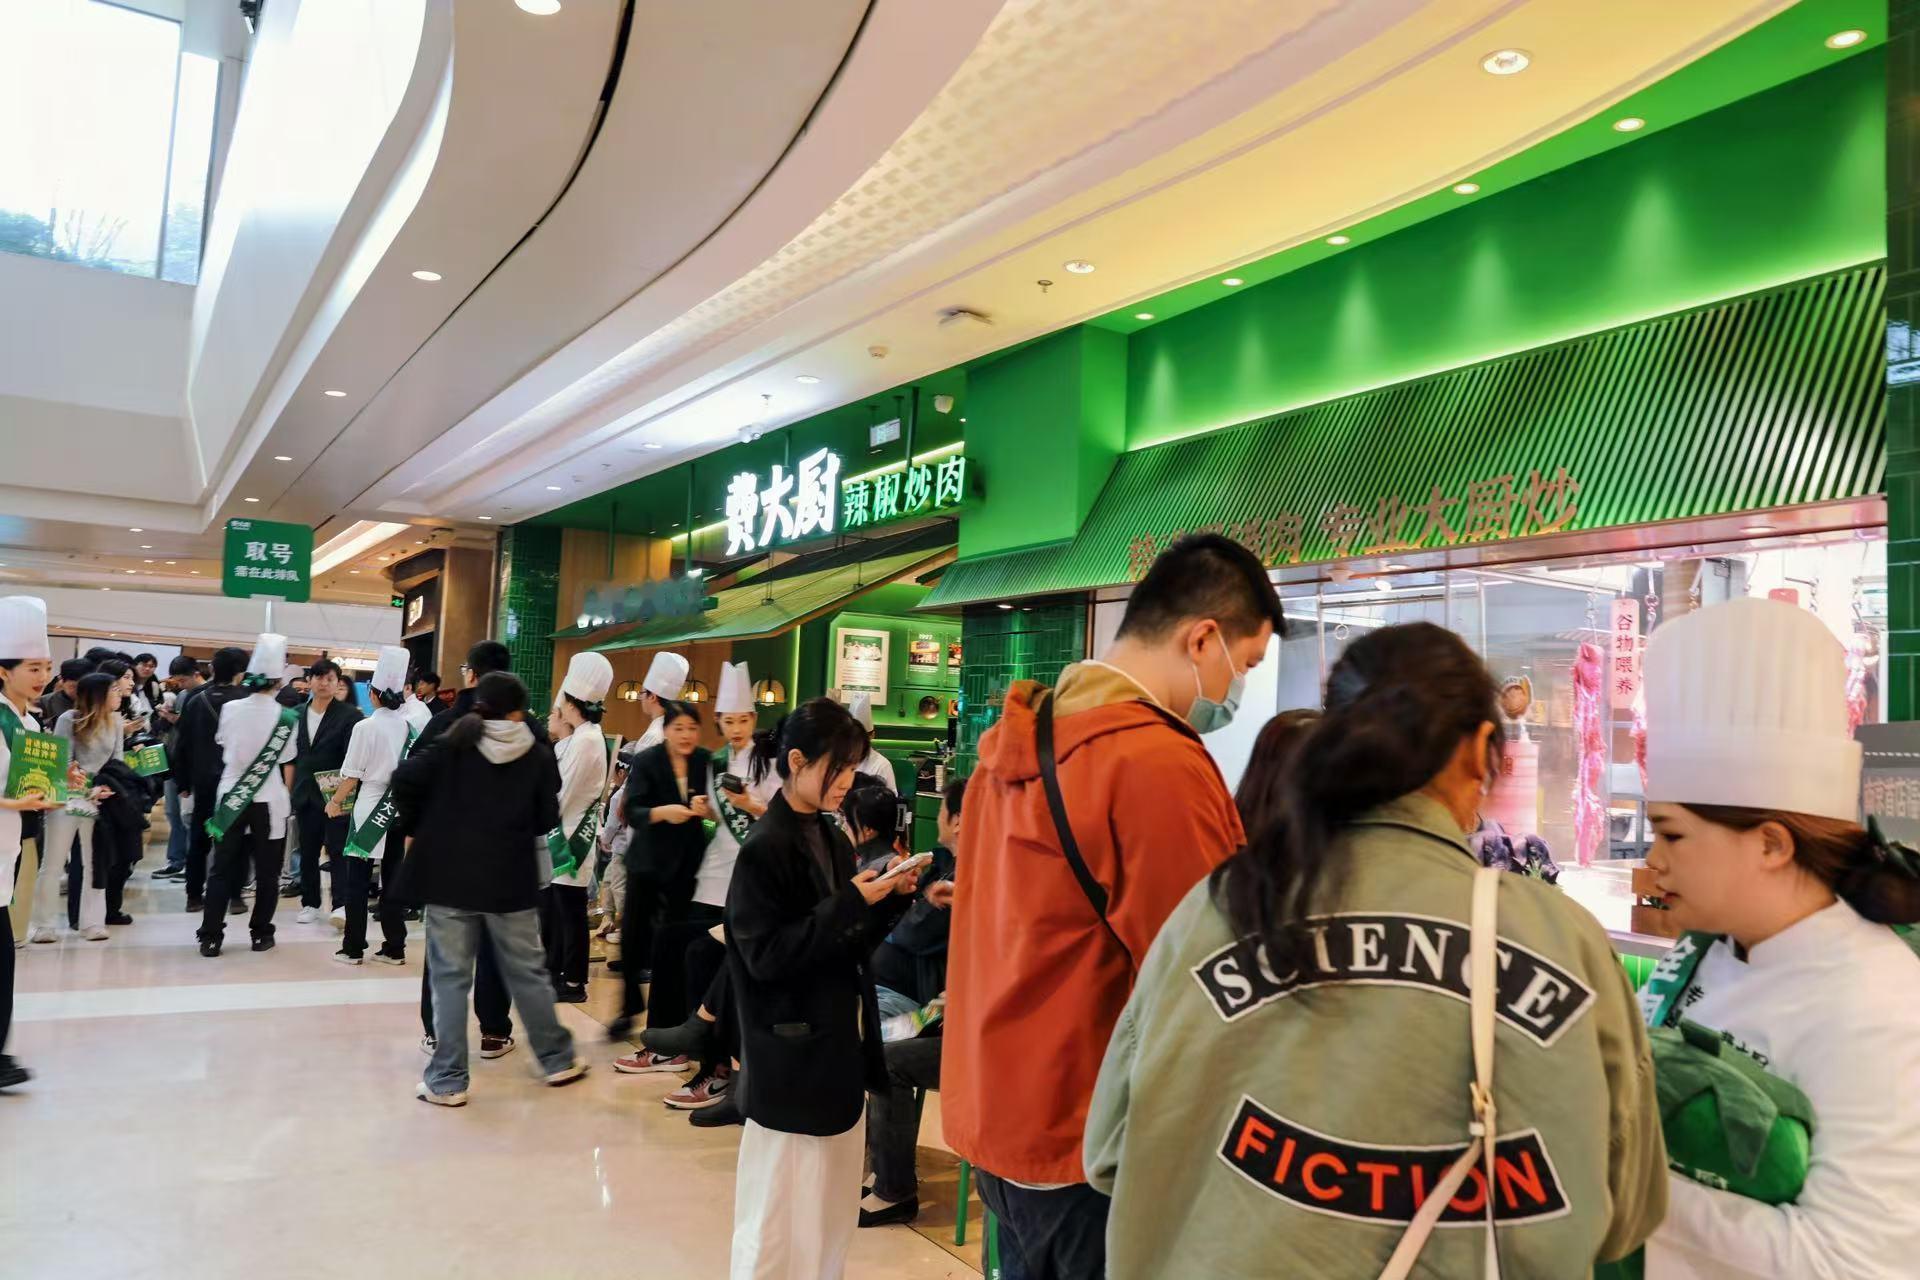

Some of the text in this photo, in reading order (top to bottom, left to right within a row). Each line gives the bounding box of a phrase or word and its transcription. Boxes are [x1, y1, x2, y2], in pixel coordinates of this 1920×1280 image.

[726, 447, 966, 556] 费大厨 辣椒炒肉
[1319, 467, 1580, 557] 专业大厨炒
[244, 541, 294, 565] 取号
[1615, 614, 1633, 695] 谷物喂养
[1235, 1116, 1548, 1213] FICTION
